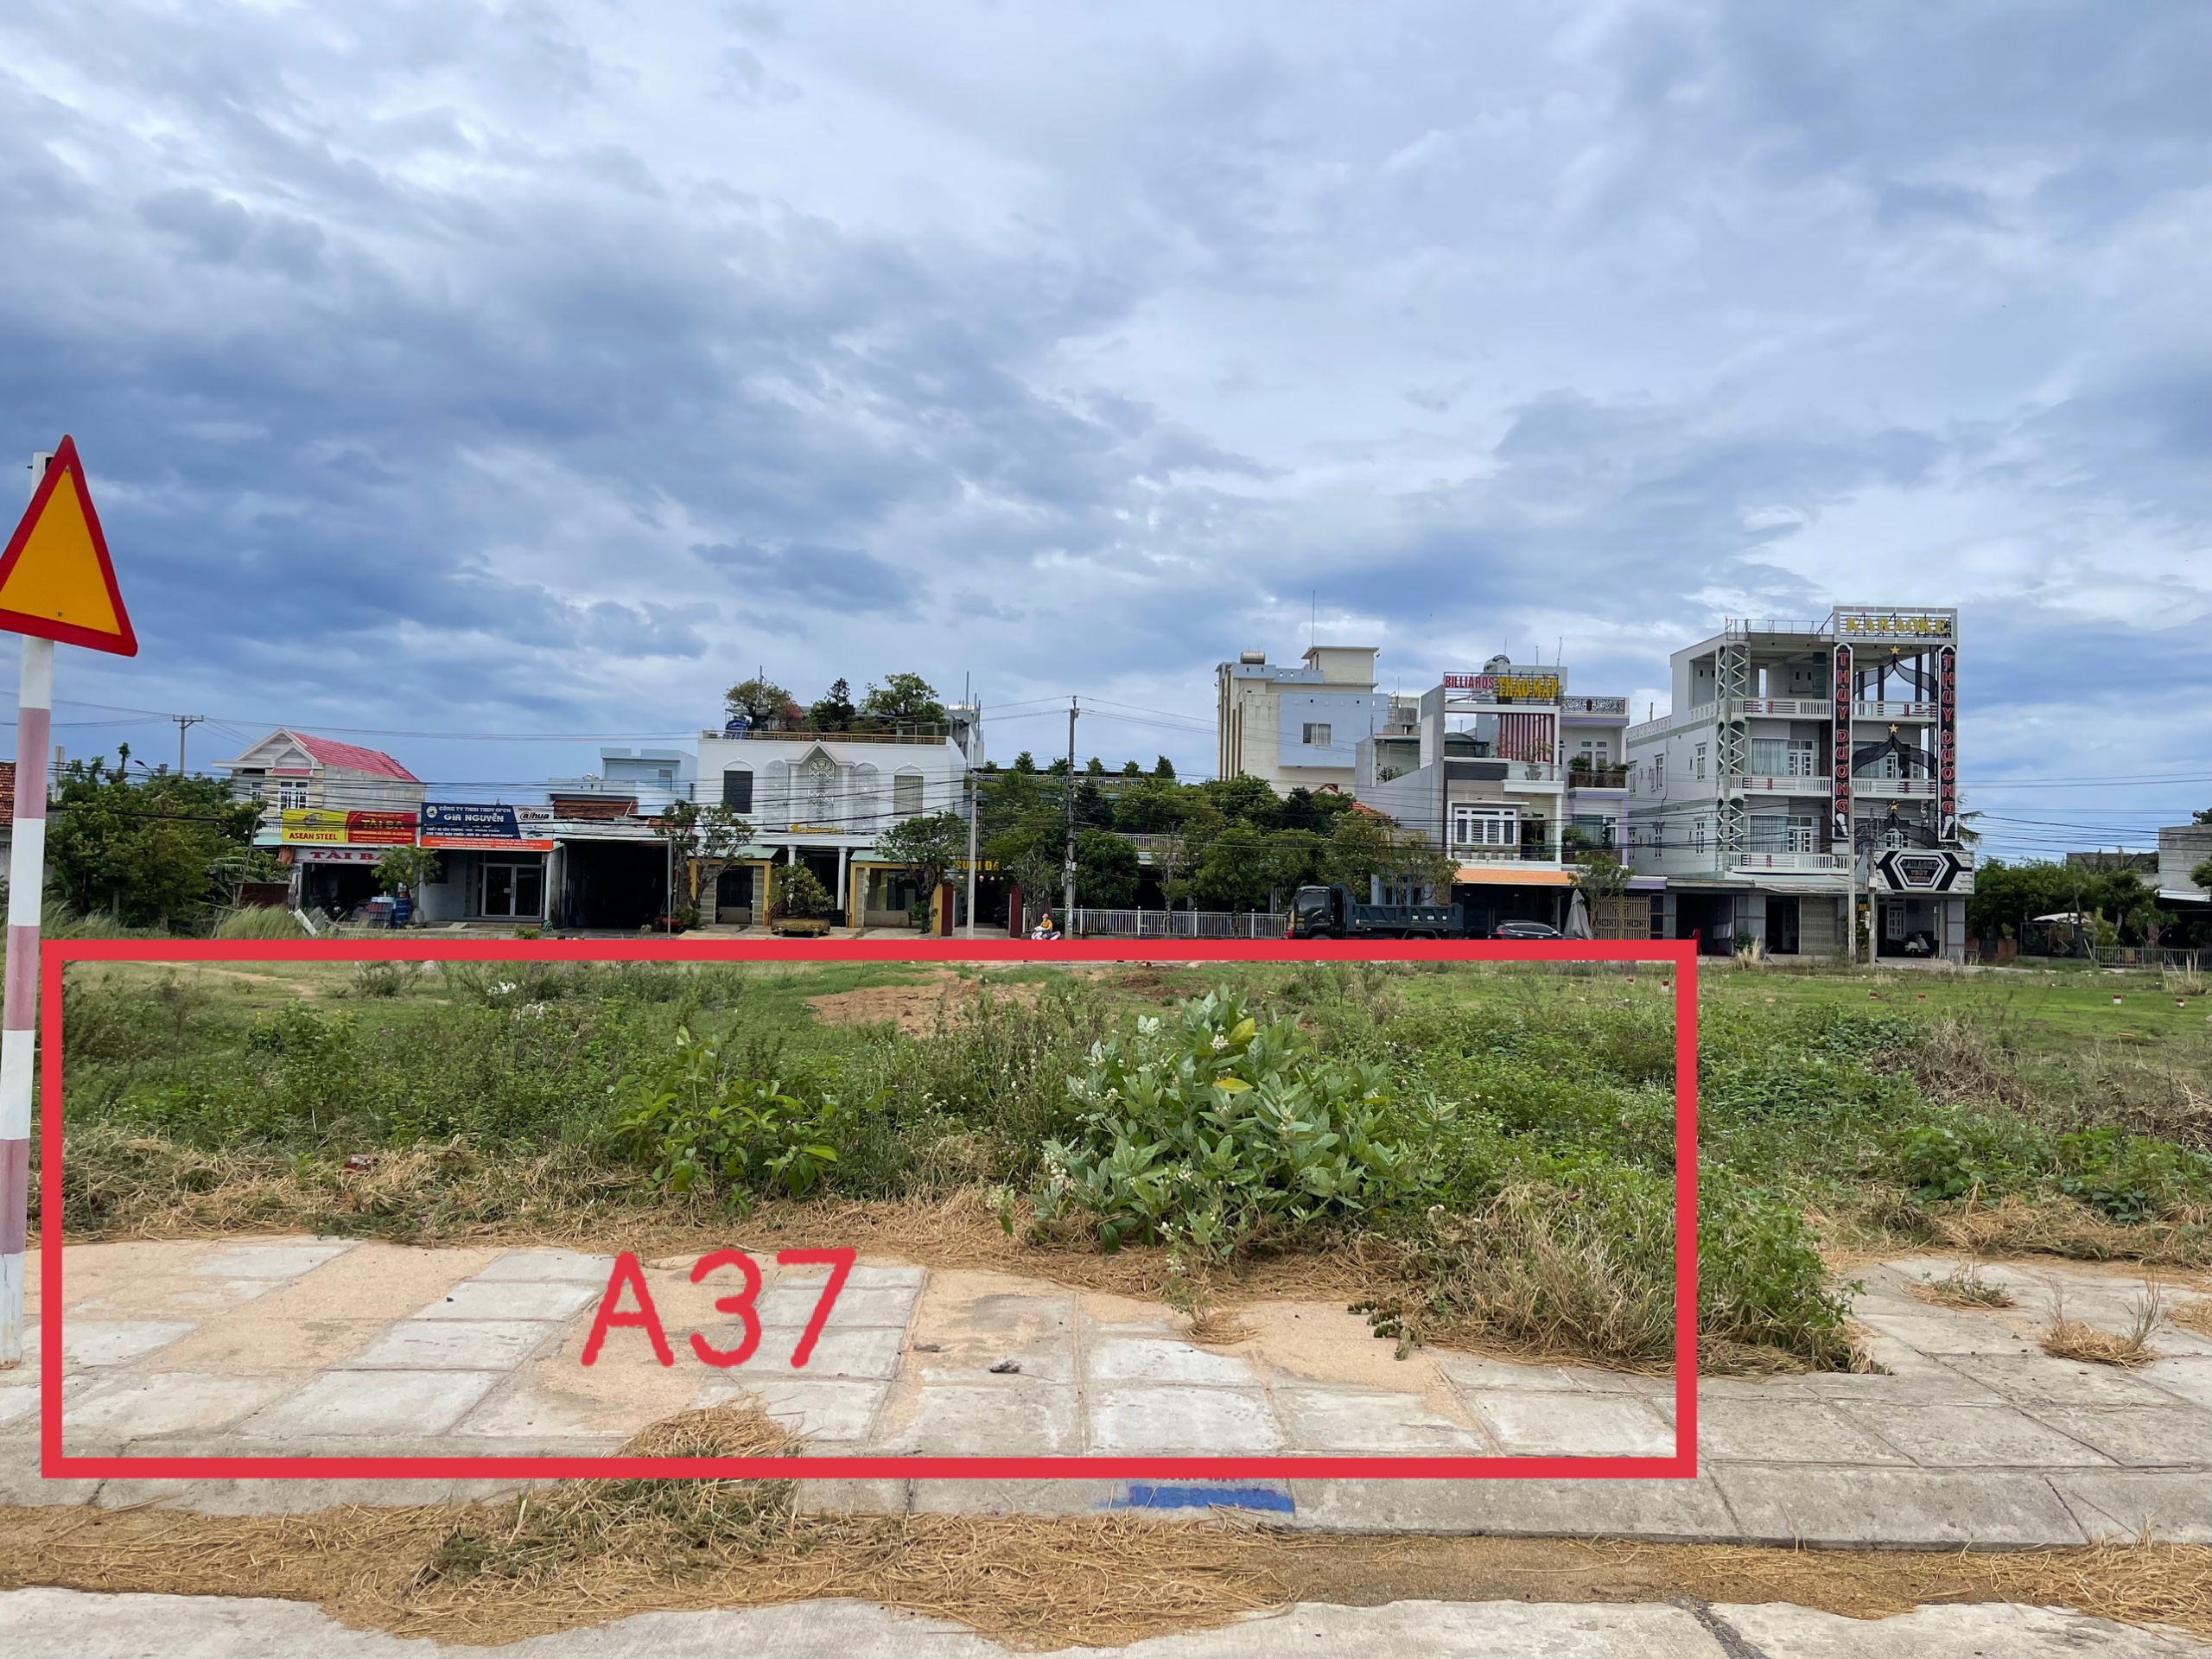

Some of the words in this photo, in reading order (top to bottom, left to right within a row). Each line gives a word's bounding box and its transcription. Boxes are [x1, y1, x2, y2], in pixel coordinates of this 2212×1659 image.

[1846, 617, 1948, 634] KARAOKE
[1445, 676, 1494, 689] BILLIARDS
[310, 850, 353, 860] TÀI
